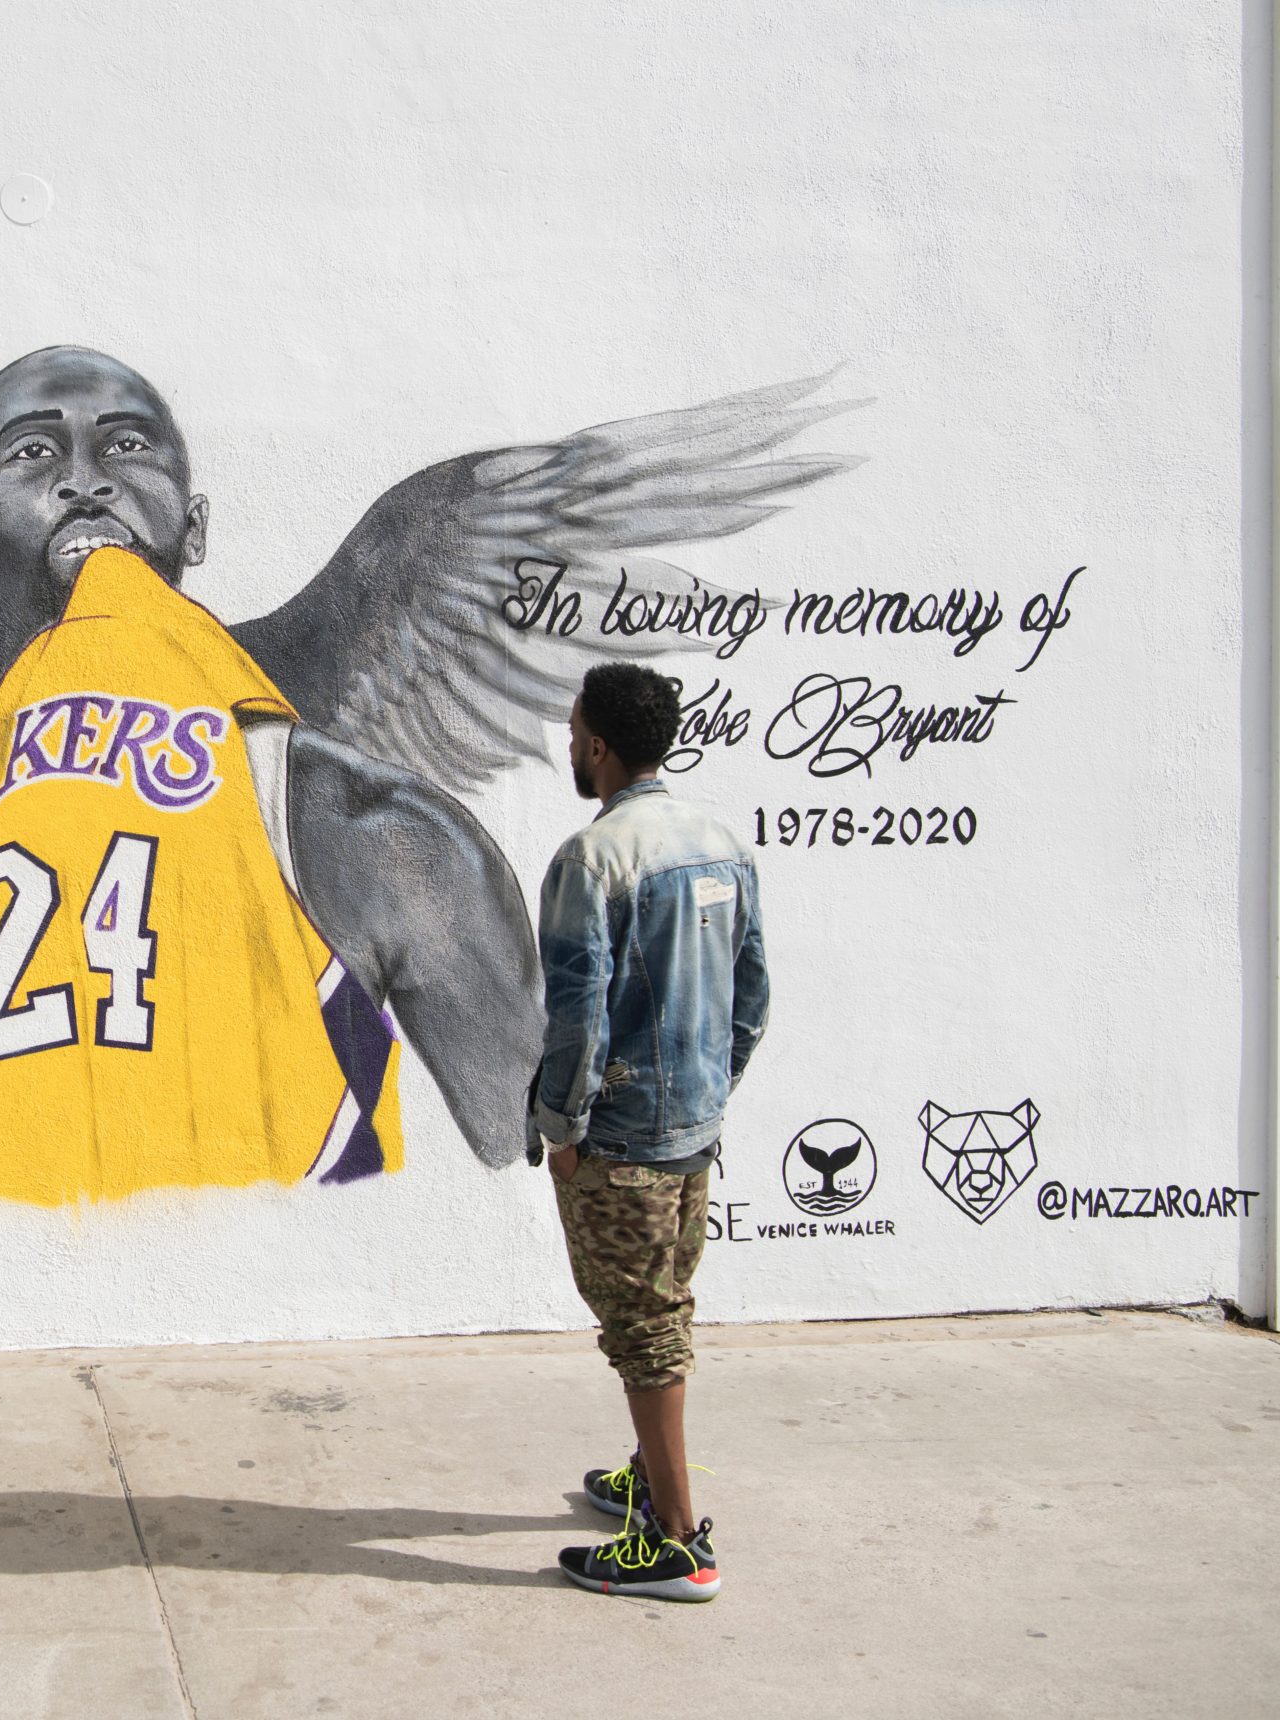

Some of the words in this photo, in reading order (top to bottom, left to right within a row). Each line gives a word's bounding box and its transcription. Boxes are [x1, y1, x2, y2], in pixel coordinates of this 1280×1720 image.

[501, 556, 583, 637] In
[600, 566, 767, 660] loving
[785, 586, 1003, 658] memory
[1015, 566, 1088, 673] of
[764, 673, 1018, 779] Bryant
[754, 806, 978, 848] 1978-2020
[1037, 1180, 1260, 1220] @MAZZARO.ART
[757, 1222, 818, 1239] VENICE
[824, 1219, 897, 1237] WHALER
